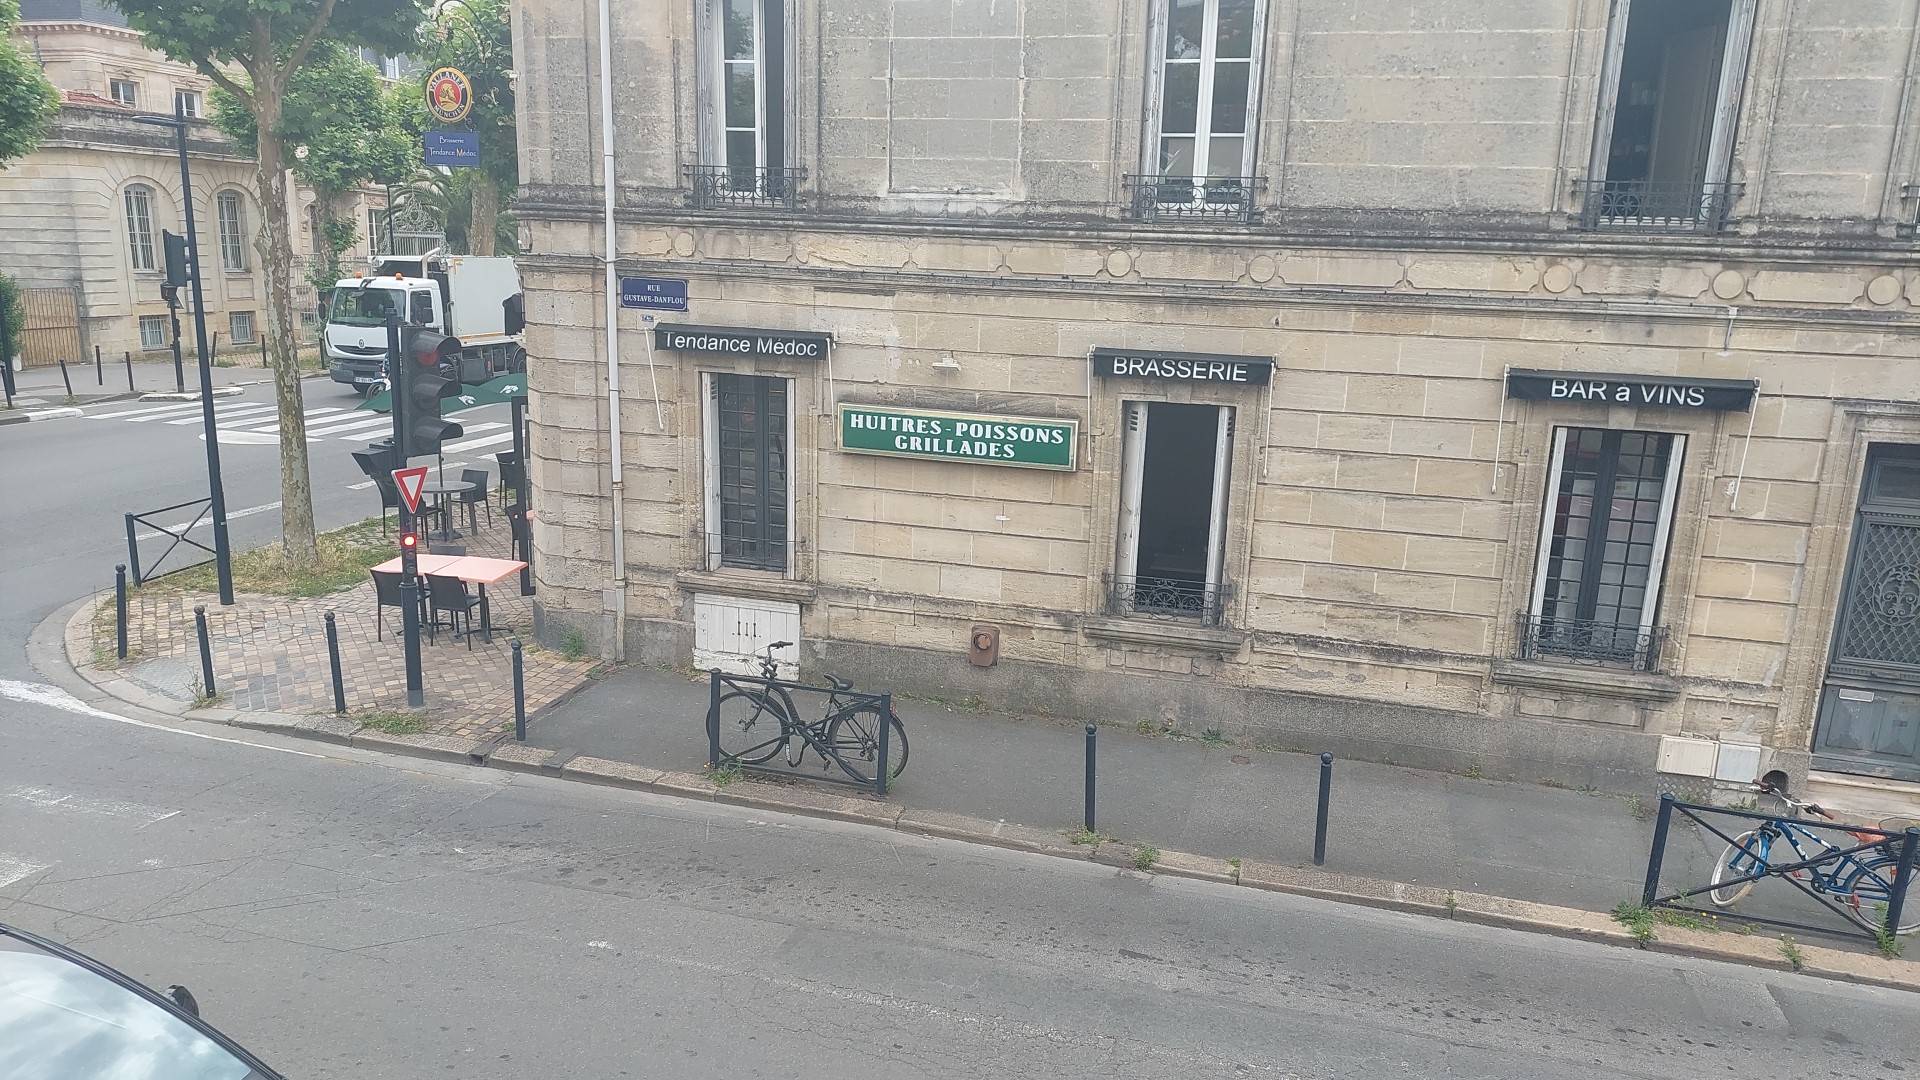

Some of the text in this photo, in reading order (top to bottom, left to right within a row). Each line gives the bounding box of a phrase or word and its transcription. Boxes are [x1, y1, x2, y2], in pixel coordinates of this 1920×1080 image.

[430, 71, 466, 92] PAULANER
[439, 136, 465, 144] Brasserie
[428, 147, 455, 156] Tendance
[647, 284, 661, 292] RUE
[623, 294, 685, 305] GUSTAVE-DANFLOU
[663, 331, 818, 356] Tendance Médoc
[1113, 356, 1248, 382] BRASSERIE
[1551, 379, 1706, 407] BAR à VINS
[895, 435, 1016, 459] GRILLADES
